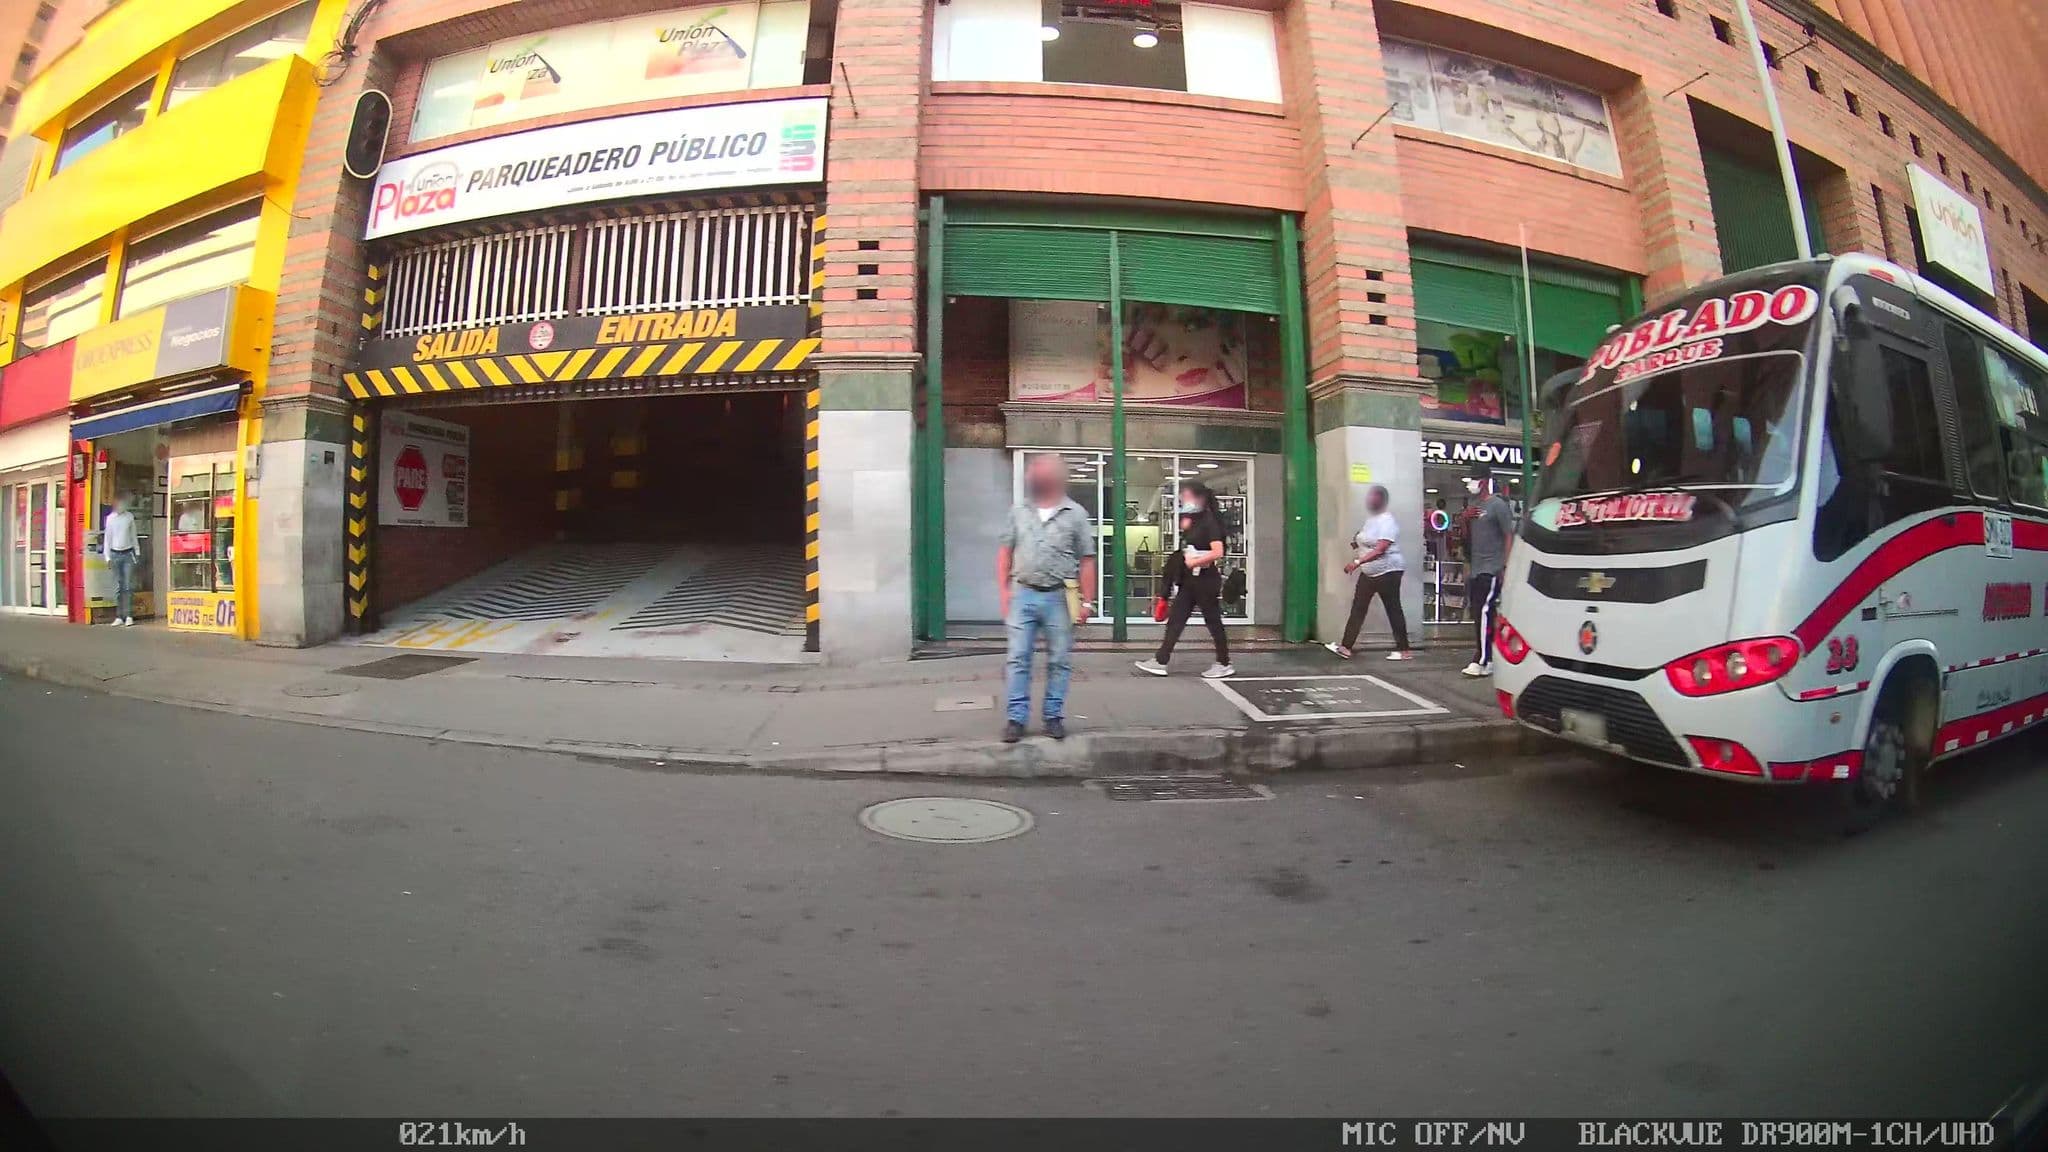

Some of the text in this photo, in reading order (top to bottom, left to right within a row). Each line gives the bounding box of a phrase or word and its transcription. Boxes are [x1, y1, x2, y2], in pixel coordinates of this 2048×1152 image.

[465, 144, 642, 194] PARQUEADERO
[648, 132, 767, 166] PÚBLICO
[372, 180, 456, 229] Plaza
[412, 326, 499, 361] SALIDA
[595, 308, 737, 345] ENTRADA
[1576, 284, 1819, 385] POBLADO
[1613, 338, 1724, 384] PARQUE
[1452, 442, 1524, 465] MÓVIL
[170, 608, 200, 625] JOYAS
